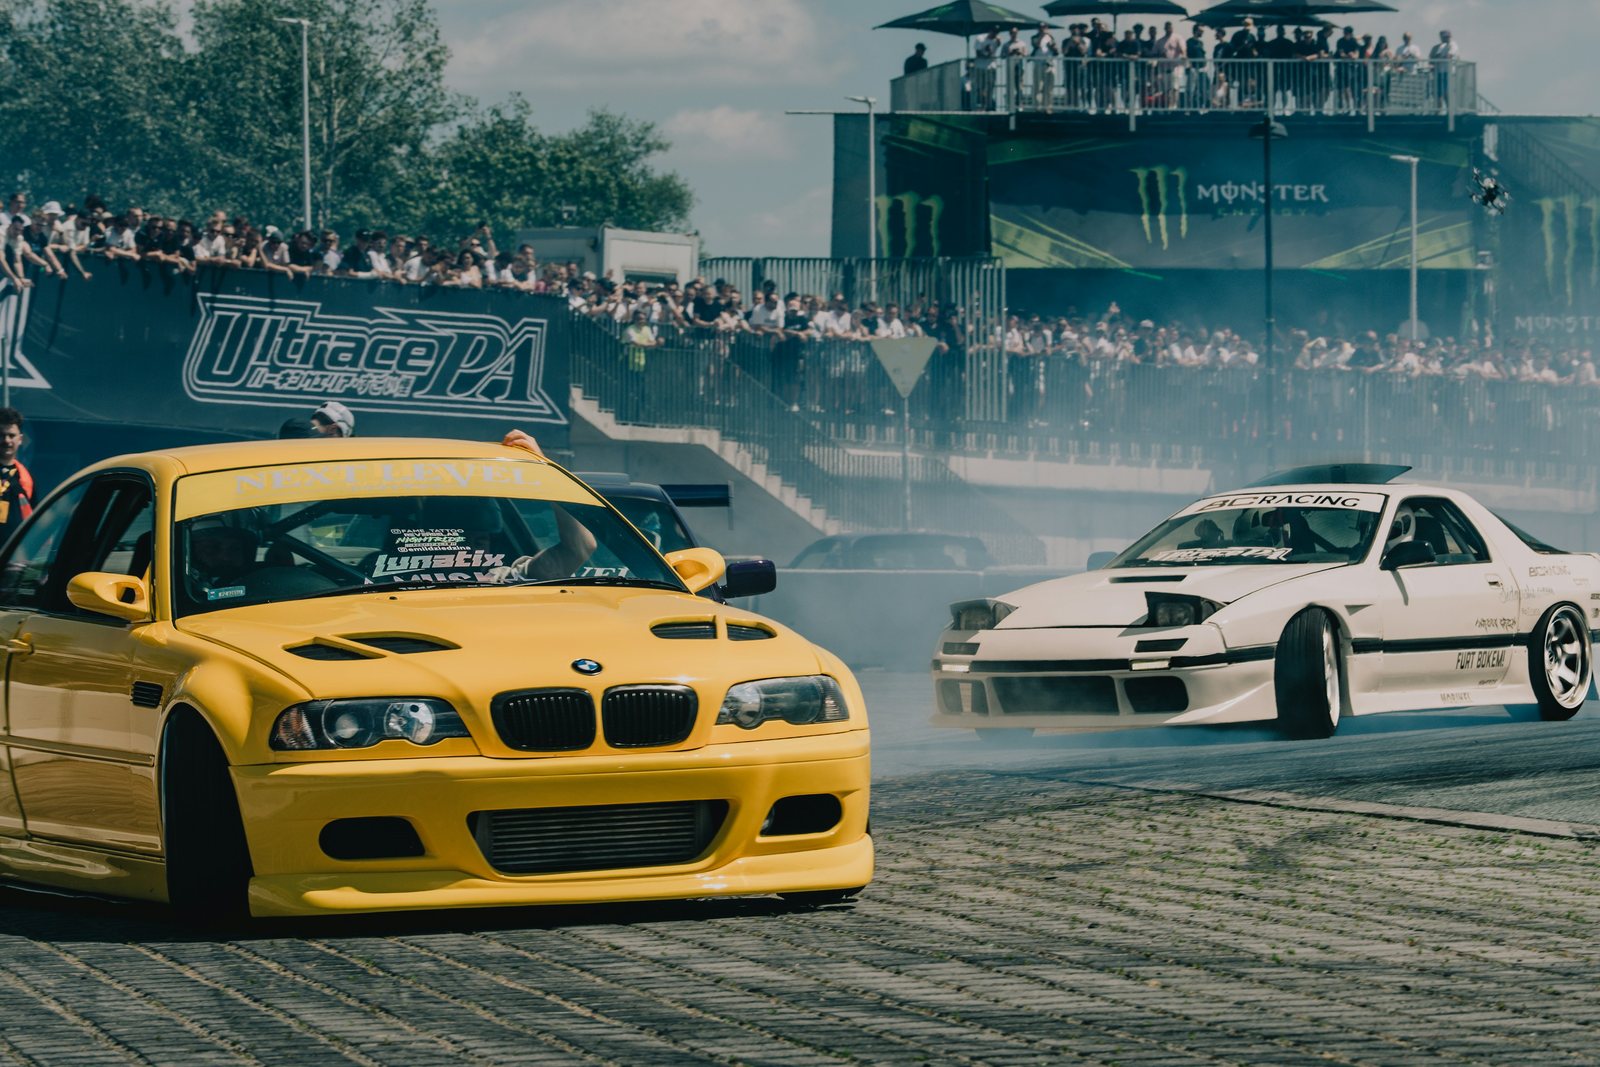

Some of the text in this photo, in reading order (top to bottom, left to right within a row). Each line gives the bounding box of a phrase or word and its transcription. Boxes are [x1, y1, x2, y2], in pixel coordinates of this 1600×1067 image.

[193, 311, 439, 387] Ultrace
[234, 463, 542, 494] NEXT LEVEL
[1258, 495, 1360, 507] RACING
[372, 550, 505, 578] Lunatix
